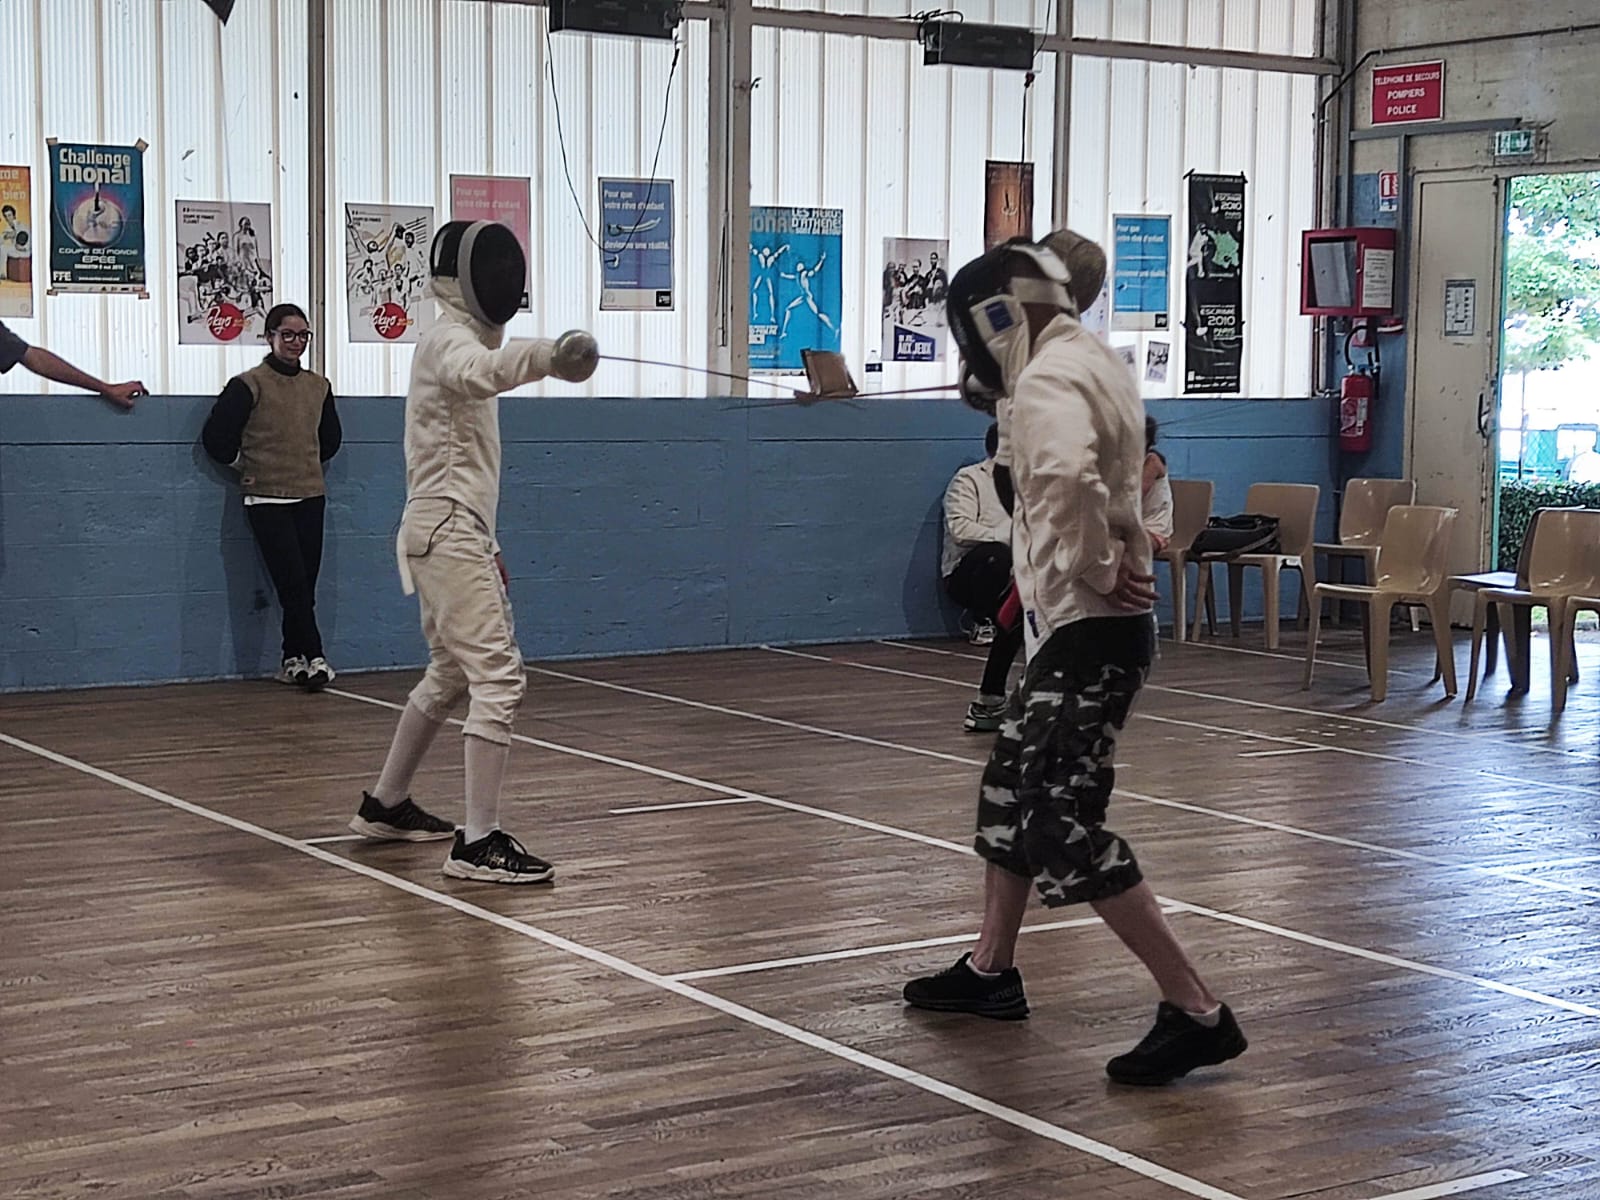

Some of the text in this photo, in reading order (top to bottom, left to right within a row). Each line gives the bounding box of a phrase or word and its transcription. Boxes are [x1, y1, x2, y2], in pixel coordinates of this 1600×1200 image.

[1405, 74, 1413, 82] DE
[1415, 71, 1440, 81] SECOURS
[1387, 87, 1425, 100] POMPIERS
[1386, 104, 1417, 116] POLICE
[59, 147, 131, 168] Challenge
[456, 187, 471, 196] Pour
[604, 190, 633, 199] Pour que
[637, 202, 664, 210] d'enfant
[1220, 201, 1242, 210] 2010
[1116, 224, 1128, 232] Pour
[53, 270, 72, 281] FFE
[1200, 308, 1235, 316] ESCRIME
[1207, 315, 1236, 326] 2010
[1213, 327, 1235, 336] PARIS
[897, 342, 932, 355] AUX JEUX
